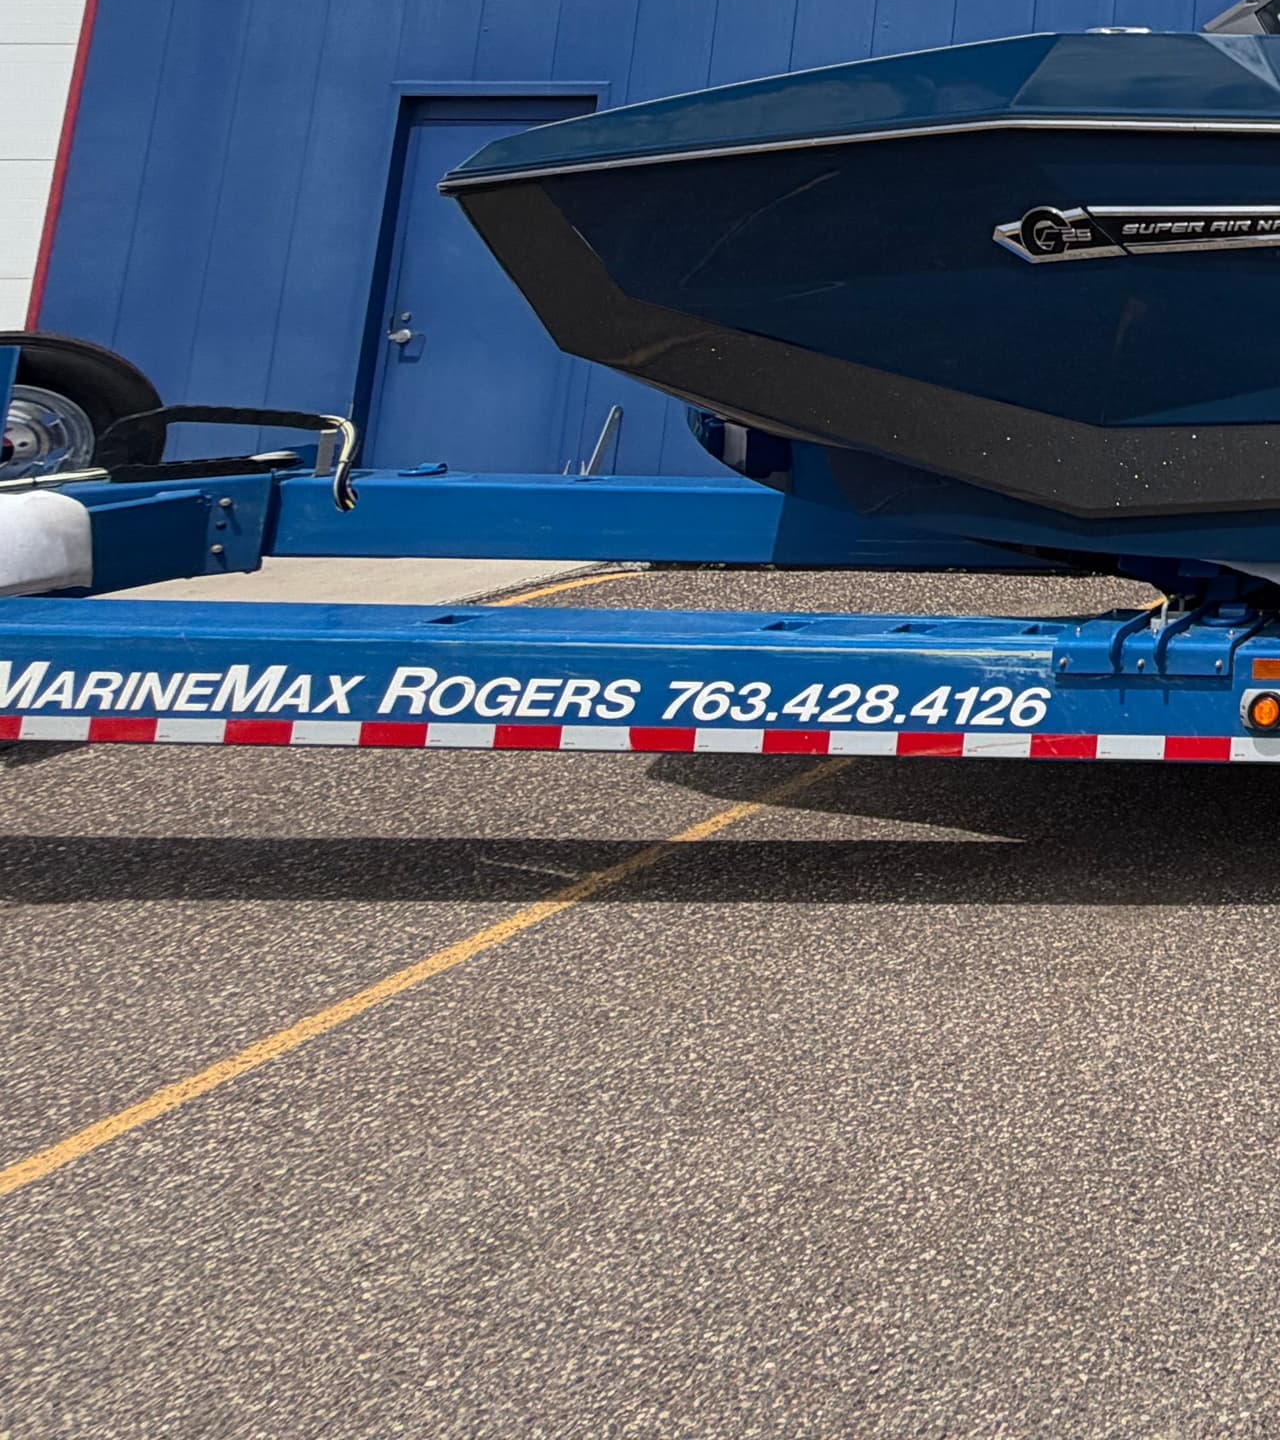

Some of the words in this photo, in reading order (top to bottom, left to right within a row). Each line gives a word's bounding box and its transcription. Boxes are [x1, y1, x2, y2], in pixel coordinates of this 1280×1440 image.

[1121, 221, 1205, 235] SUPER
[1209, 220, 1252, 232] AIR
[662, 681, 1052, 727] 763.428.4126
